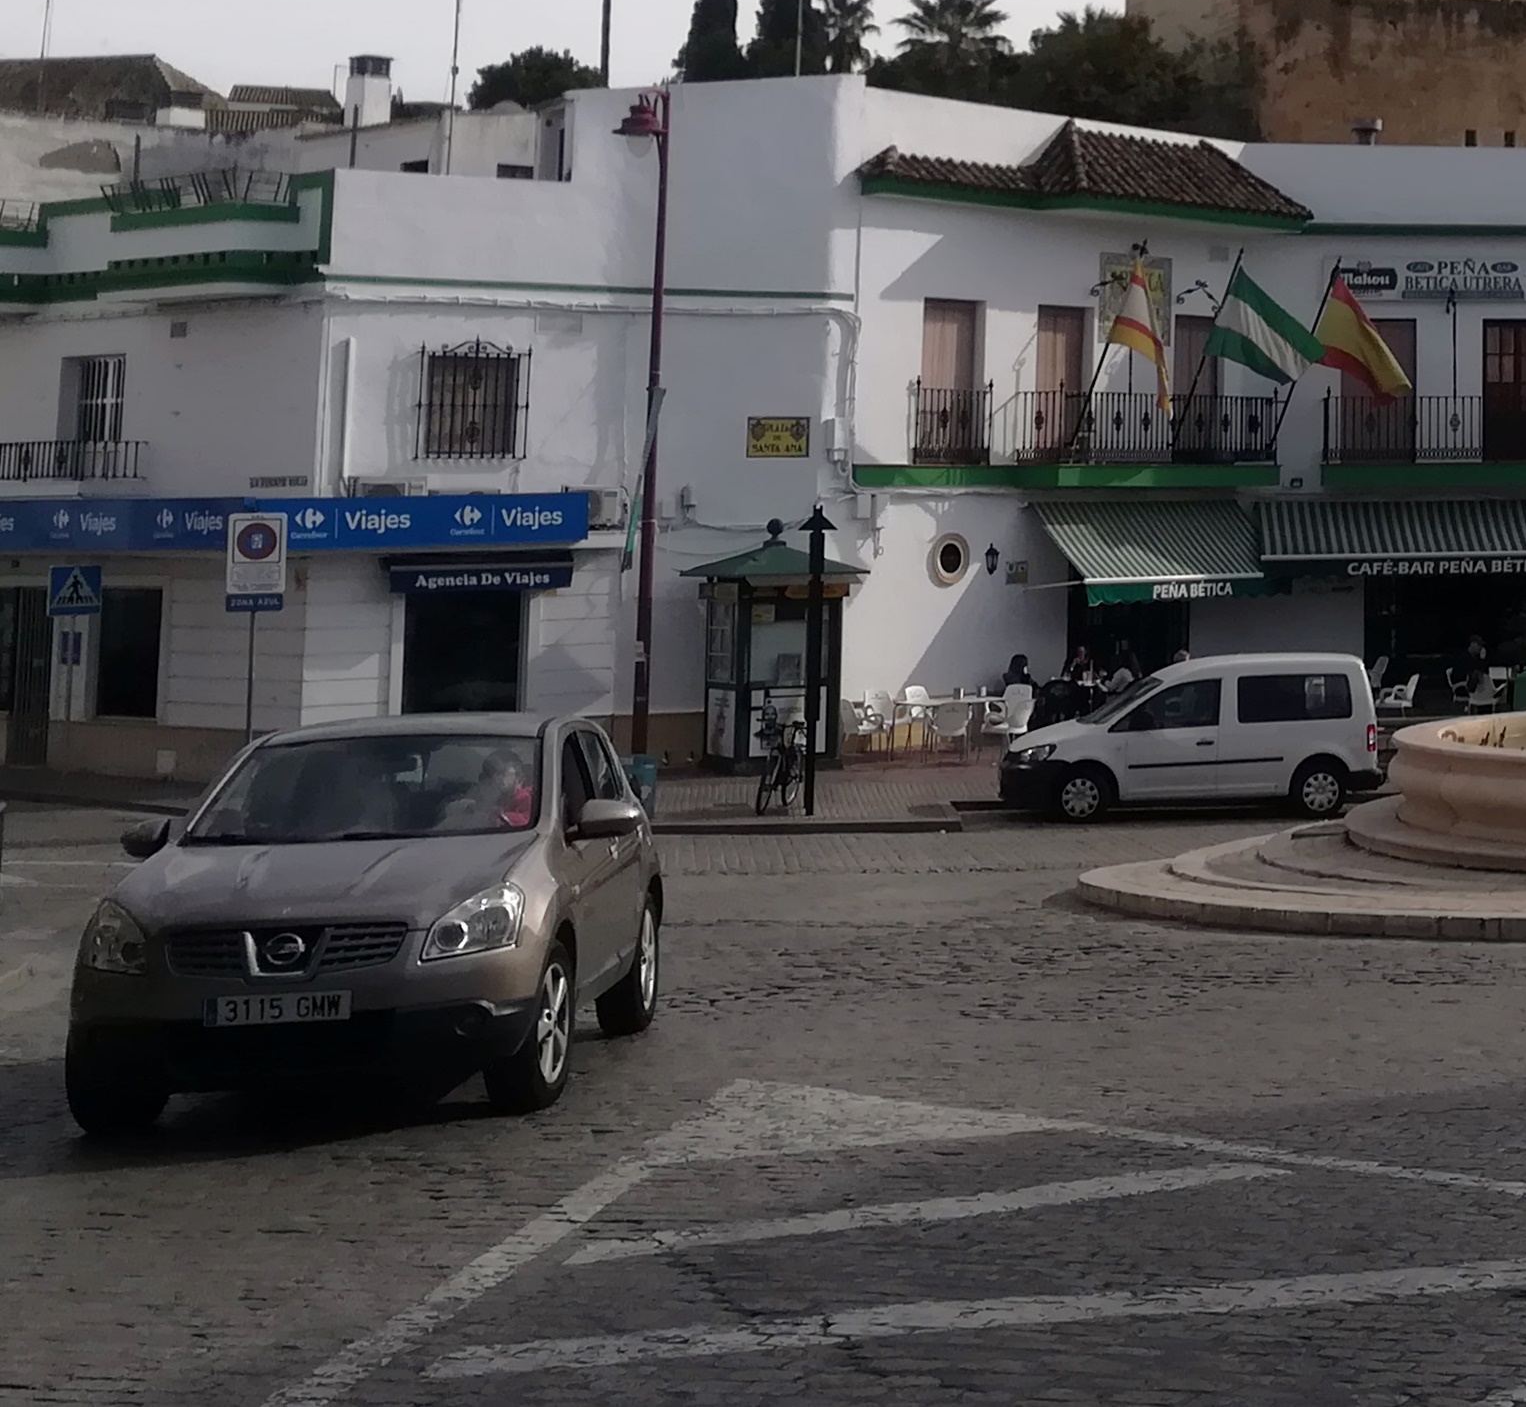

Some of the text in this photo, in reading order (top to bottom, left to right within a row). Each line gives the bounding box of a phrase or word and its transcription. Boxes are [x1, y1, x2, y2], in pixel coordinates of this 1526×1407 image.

[1437, 258, 1490, 275] PEÑA
[1405, 275, 1523, 291] BETICA UTRERA
[752, 443, 803, 453] SANTA ANA
[80, 512, 116, 536] Viajes
[185, 510, 223, 536] Viajes
[344, 508, 411, 534] Viajes
[501, 505, 563, 531] Viajes
[1347, 559, 1434, 576] CAFÉ-BAR
[1439, 557, 1487, 574] PEÑA
[415, 571, 550, 590] Agencia De Viajes
[1152, 580, 1233, 600] PEÑA BÉTICA
[230, 597, 281, 607] ZONA AZUL
[225, 994, 341, 1023] 3115 GMW
